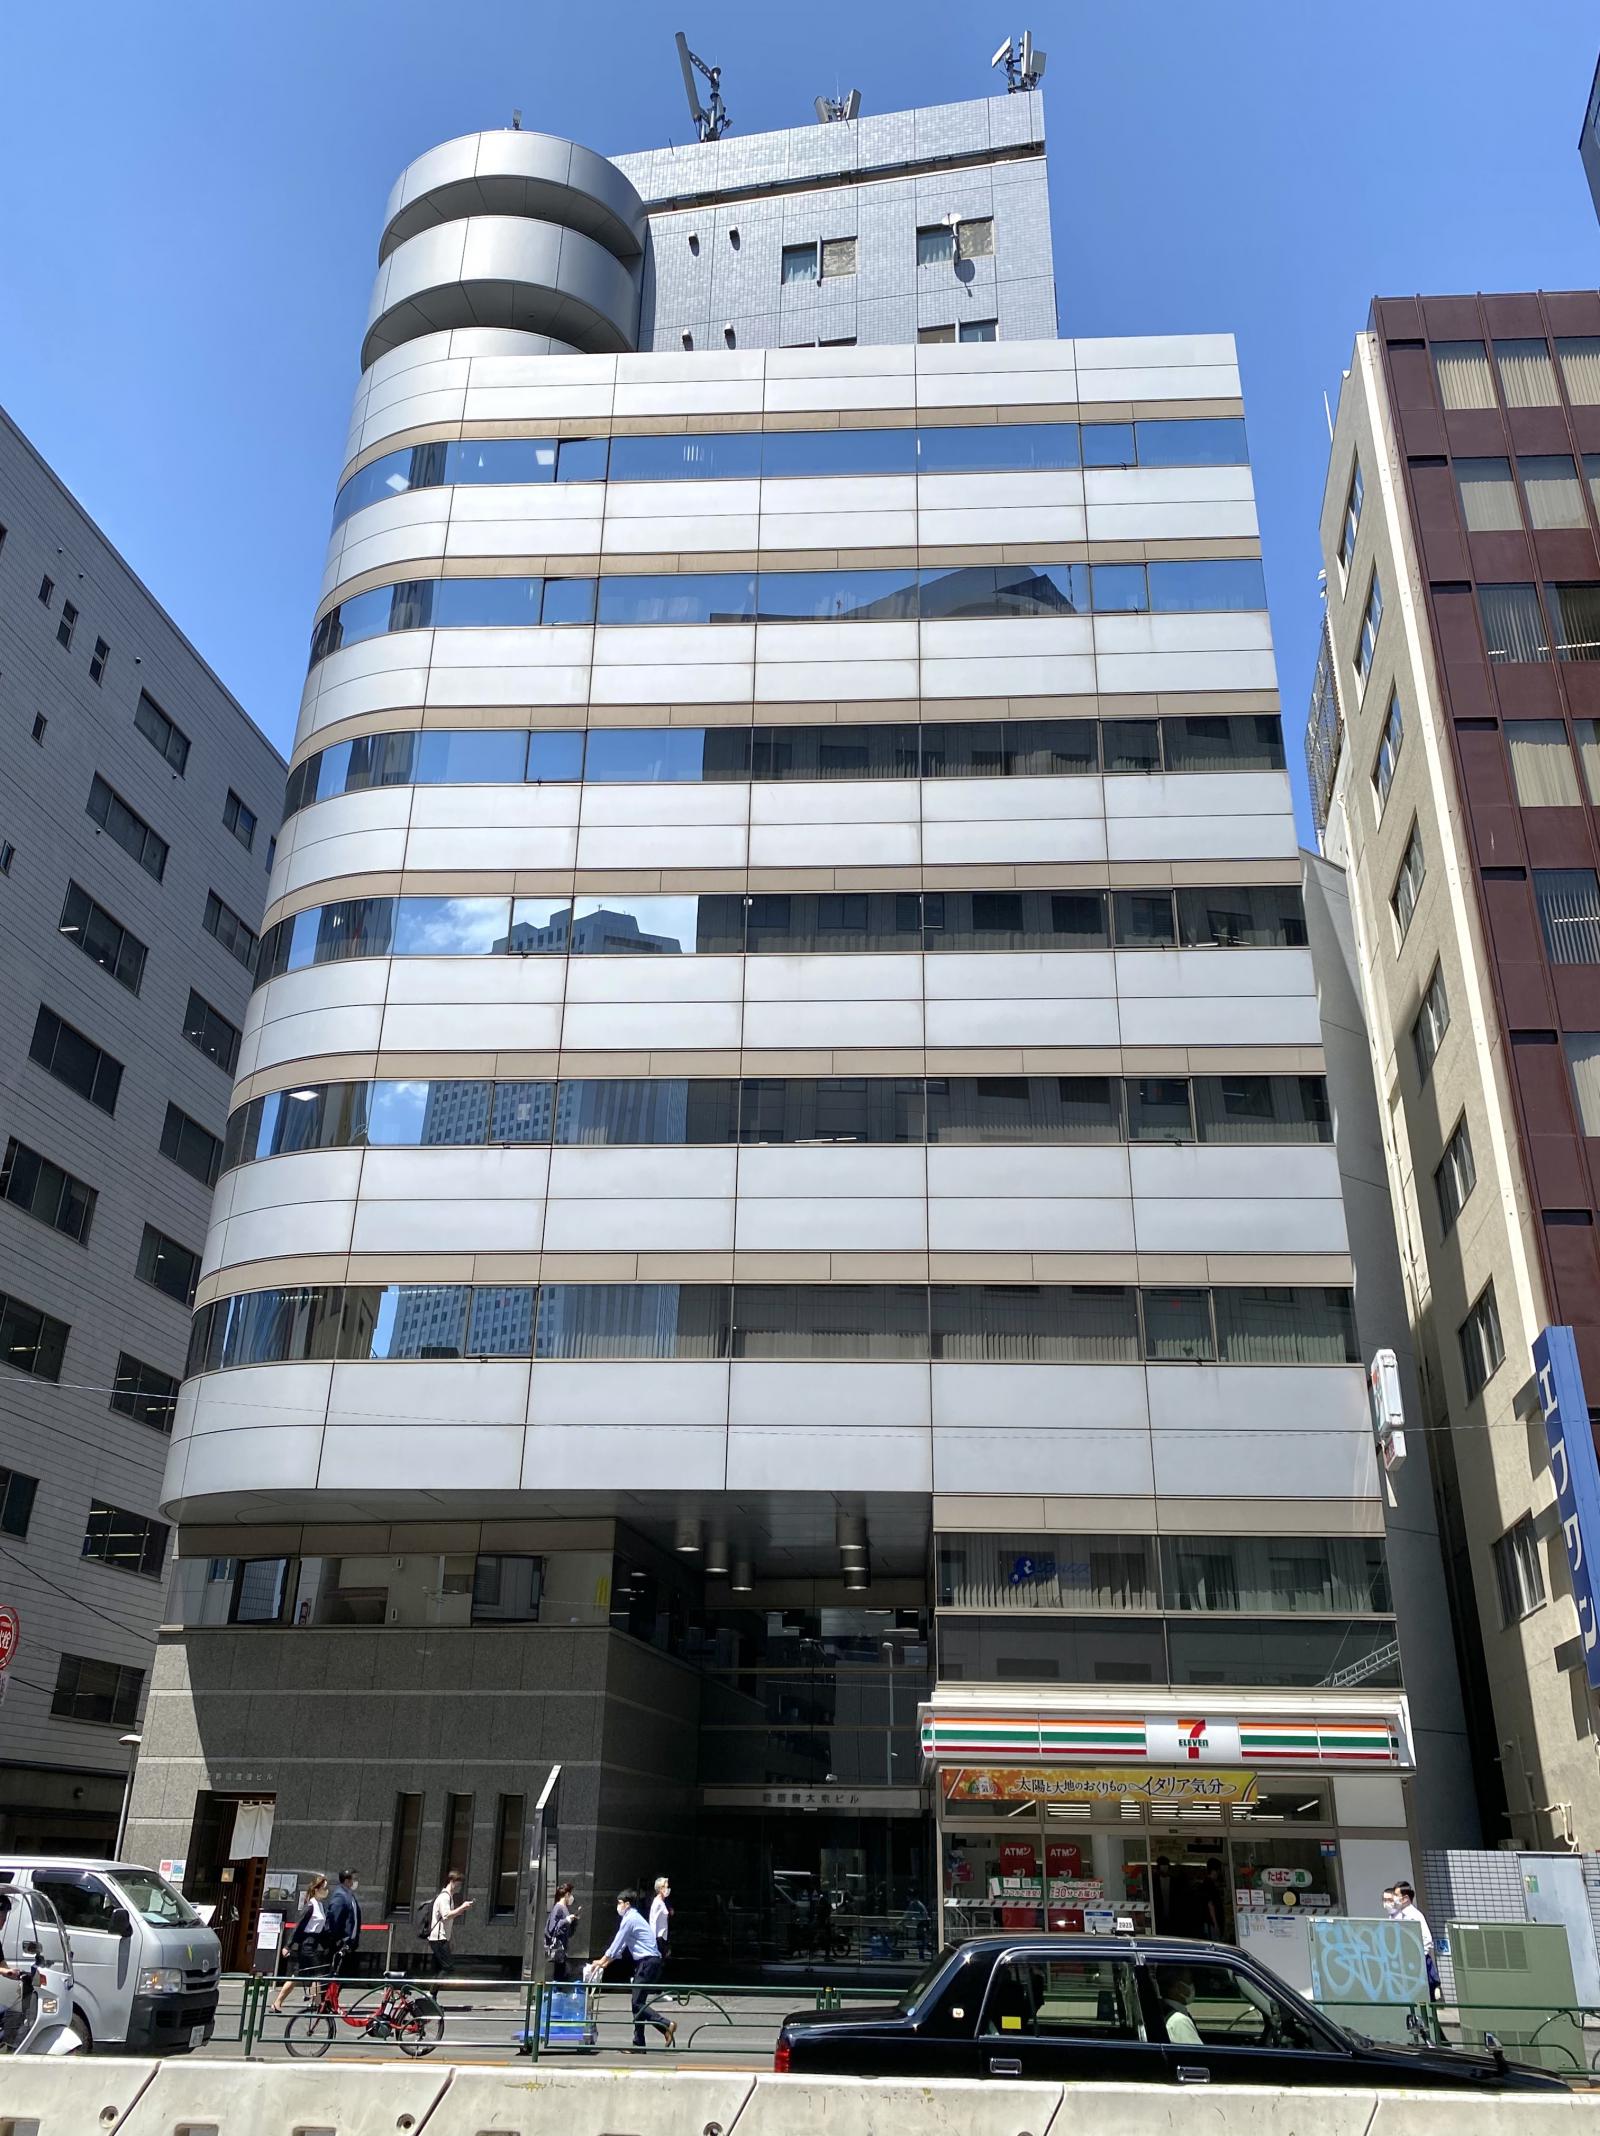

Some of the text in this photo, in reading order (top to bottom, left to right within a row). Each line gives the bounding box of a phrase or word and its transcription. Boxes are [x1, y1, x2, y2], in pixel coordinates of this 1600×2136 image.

[1016, 1776, 1127, 1795] 太陽と大地のおくりもの
[1142, 1775, 1224, 1796] イタリア気分
[1267, 1871, 1290, 1882] たばこ
